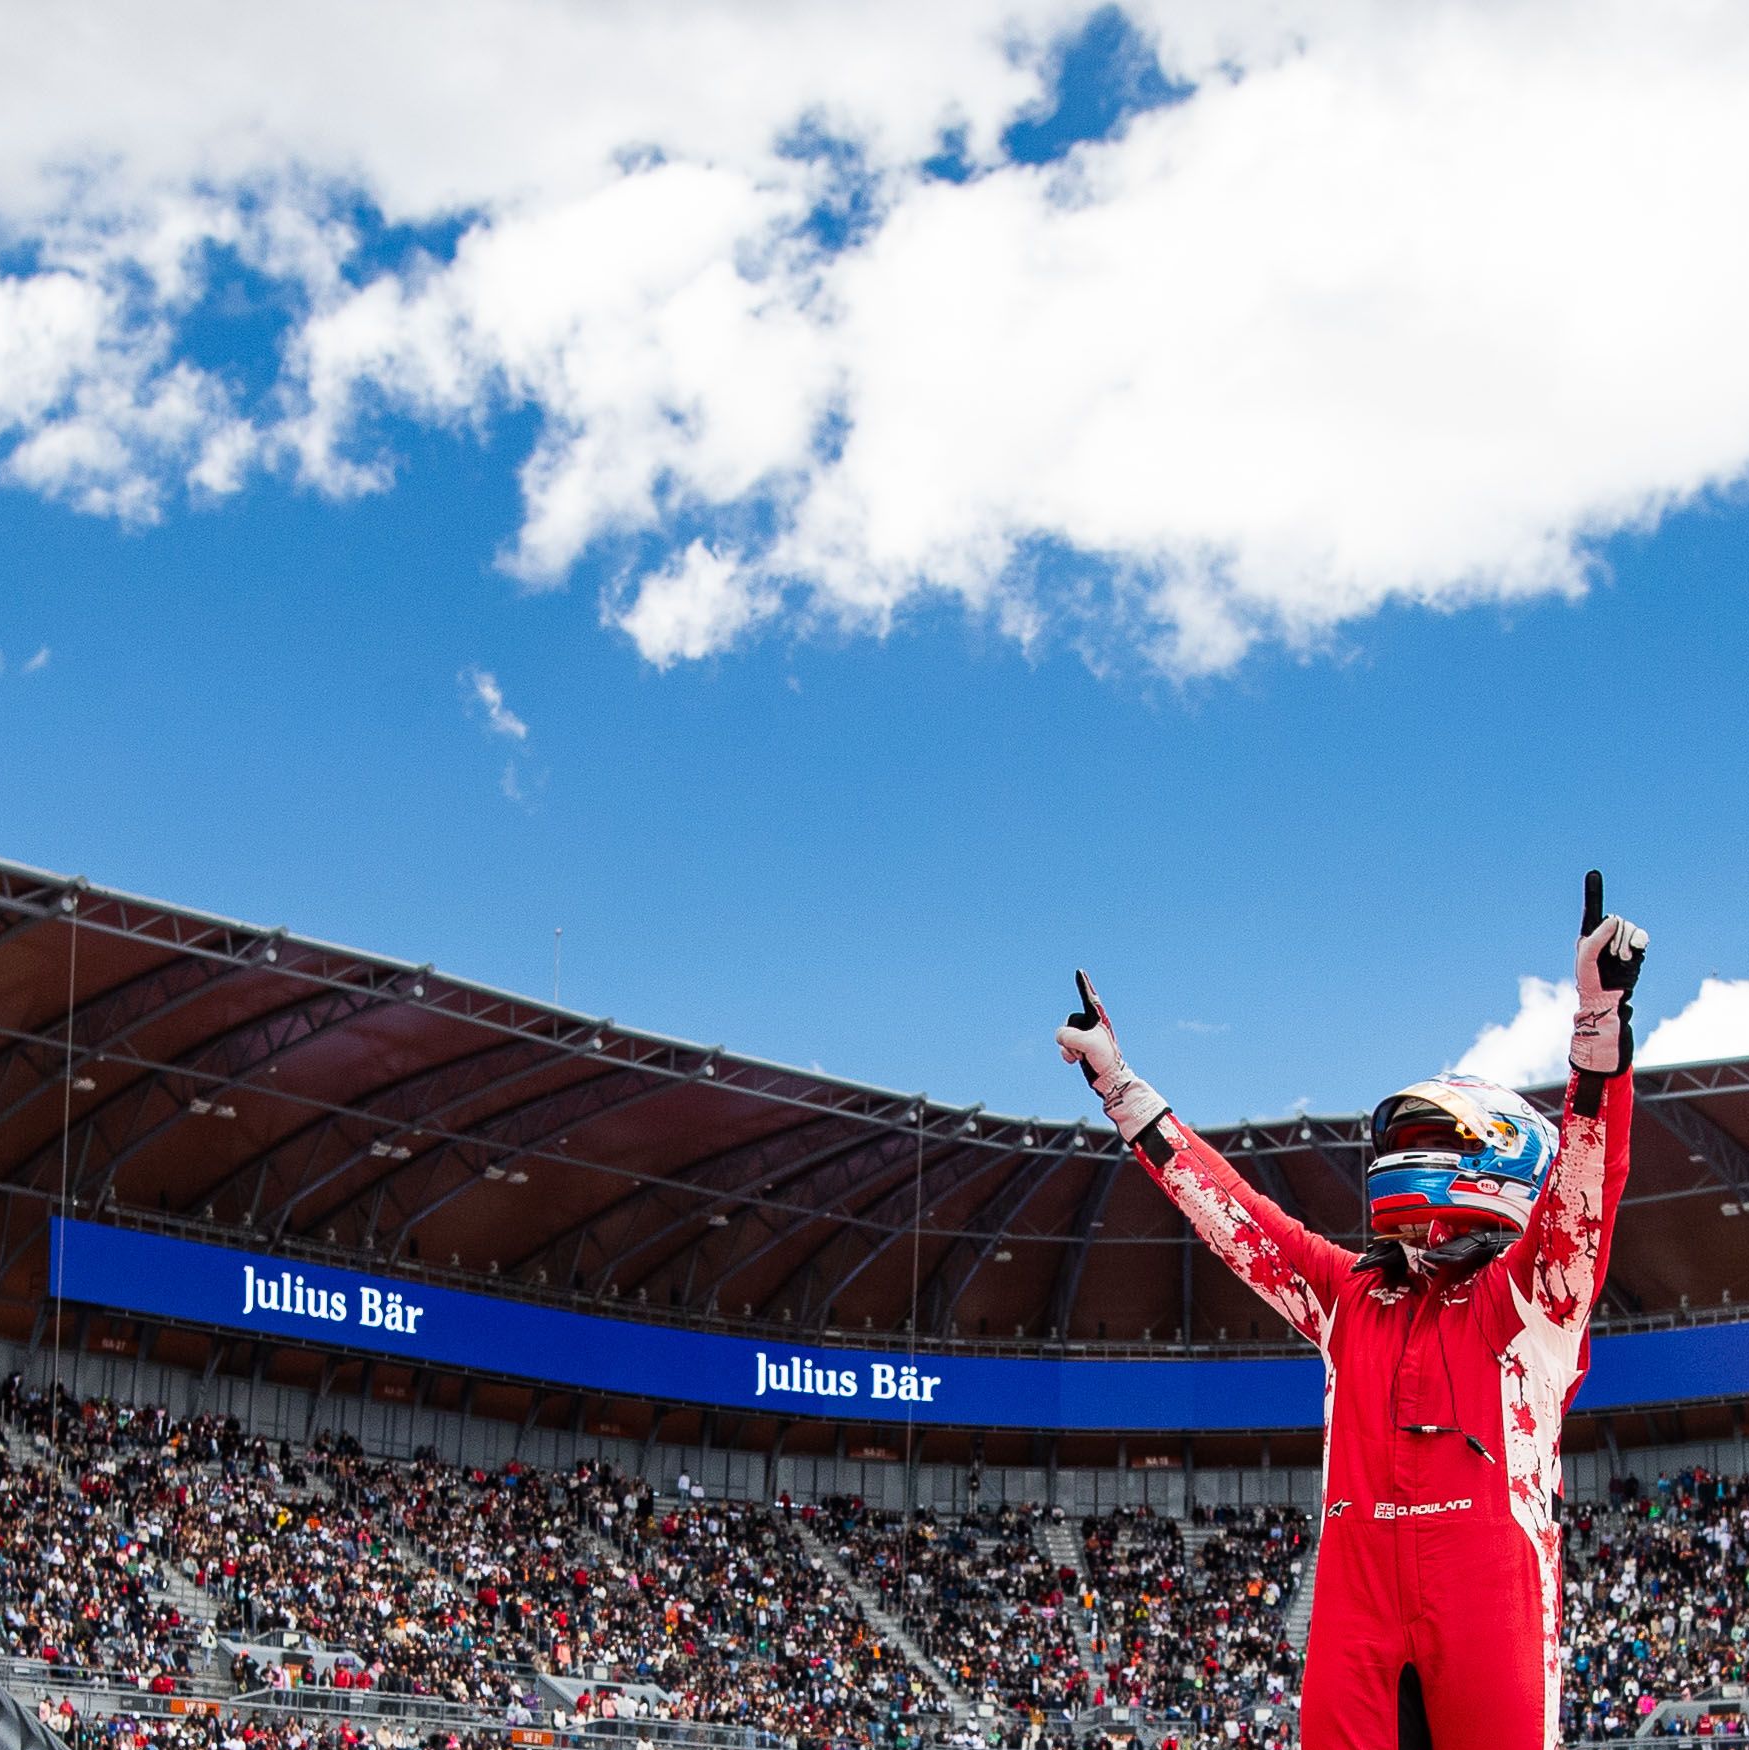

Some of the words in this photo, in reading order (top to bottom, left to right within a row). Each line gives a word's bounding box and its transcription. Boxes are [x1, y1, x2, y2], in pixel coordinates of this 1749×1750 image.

[242, 1265, 347, 1322] Julius
[359, 1286, 424, 1334] Bär
[755, 1352, 858, 1397] Julius
[870, 1363, 942, 1402] Bär
[1410, 1498, 1472, 1516] ROWLAND
